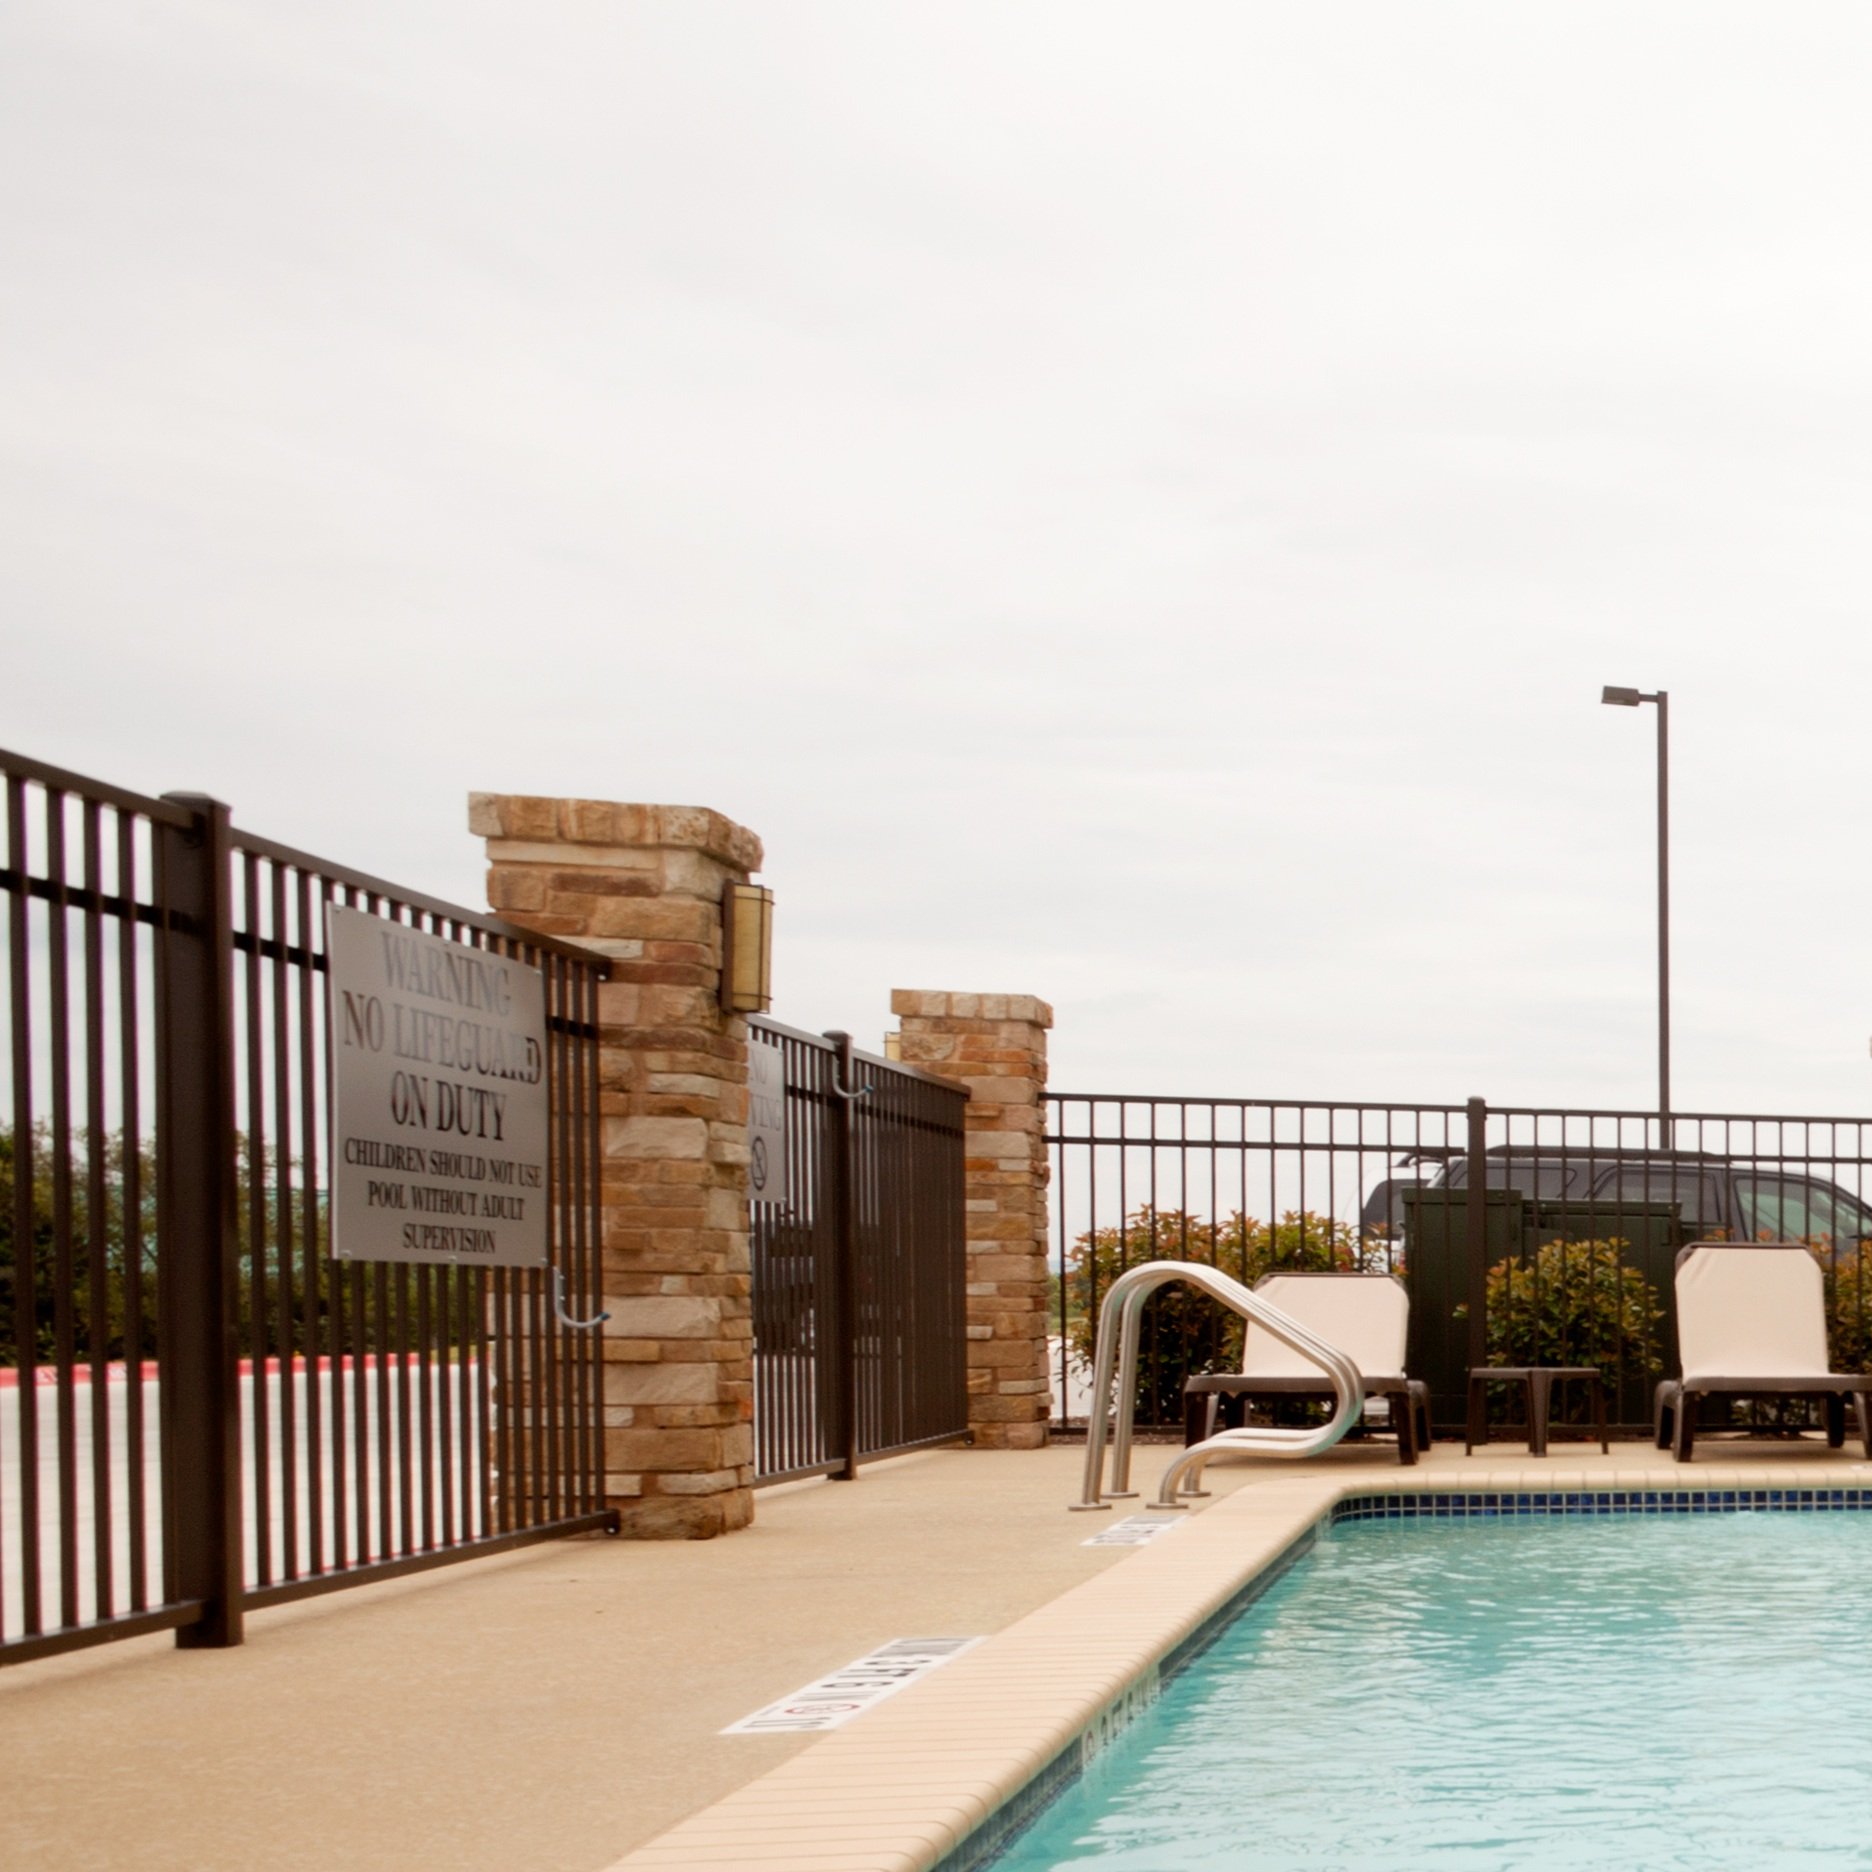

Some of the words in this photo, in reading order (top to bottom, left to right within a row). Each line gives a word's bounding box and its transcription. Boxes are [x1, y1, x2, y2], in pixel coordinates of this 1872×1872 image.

[381, 931, 512, 1017] WARNING
[342, 990, 385, 1053] NO
[392, 1003, 542, 1084] LIFEGUARD
[391, 1070, 429, 1129] ON
[436, 1080, 507, 1141] DUTY
[344, 1137, 427, 1174] CHILDREN
[429, 1149, 486, 1181] SHOULD
[489, 1158, 514, 1185] NOT
[517, 1163, 543, 1188] USE
[367, 1180, 407, 1210] POOL
[411, 1185, 478, 1216] WITHOUT
[481, 1194, 525, 1220] ADULT
[402, 1223, 496, 1253] SUPERVISION
